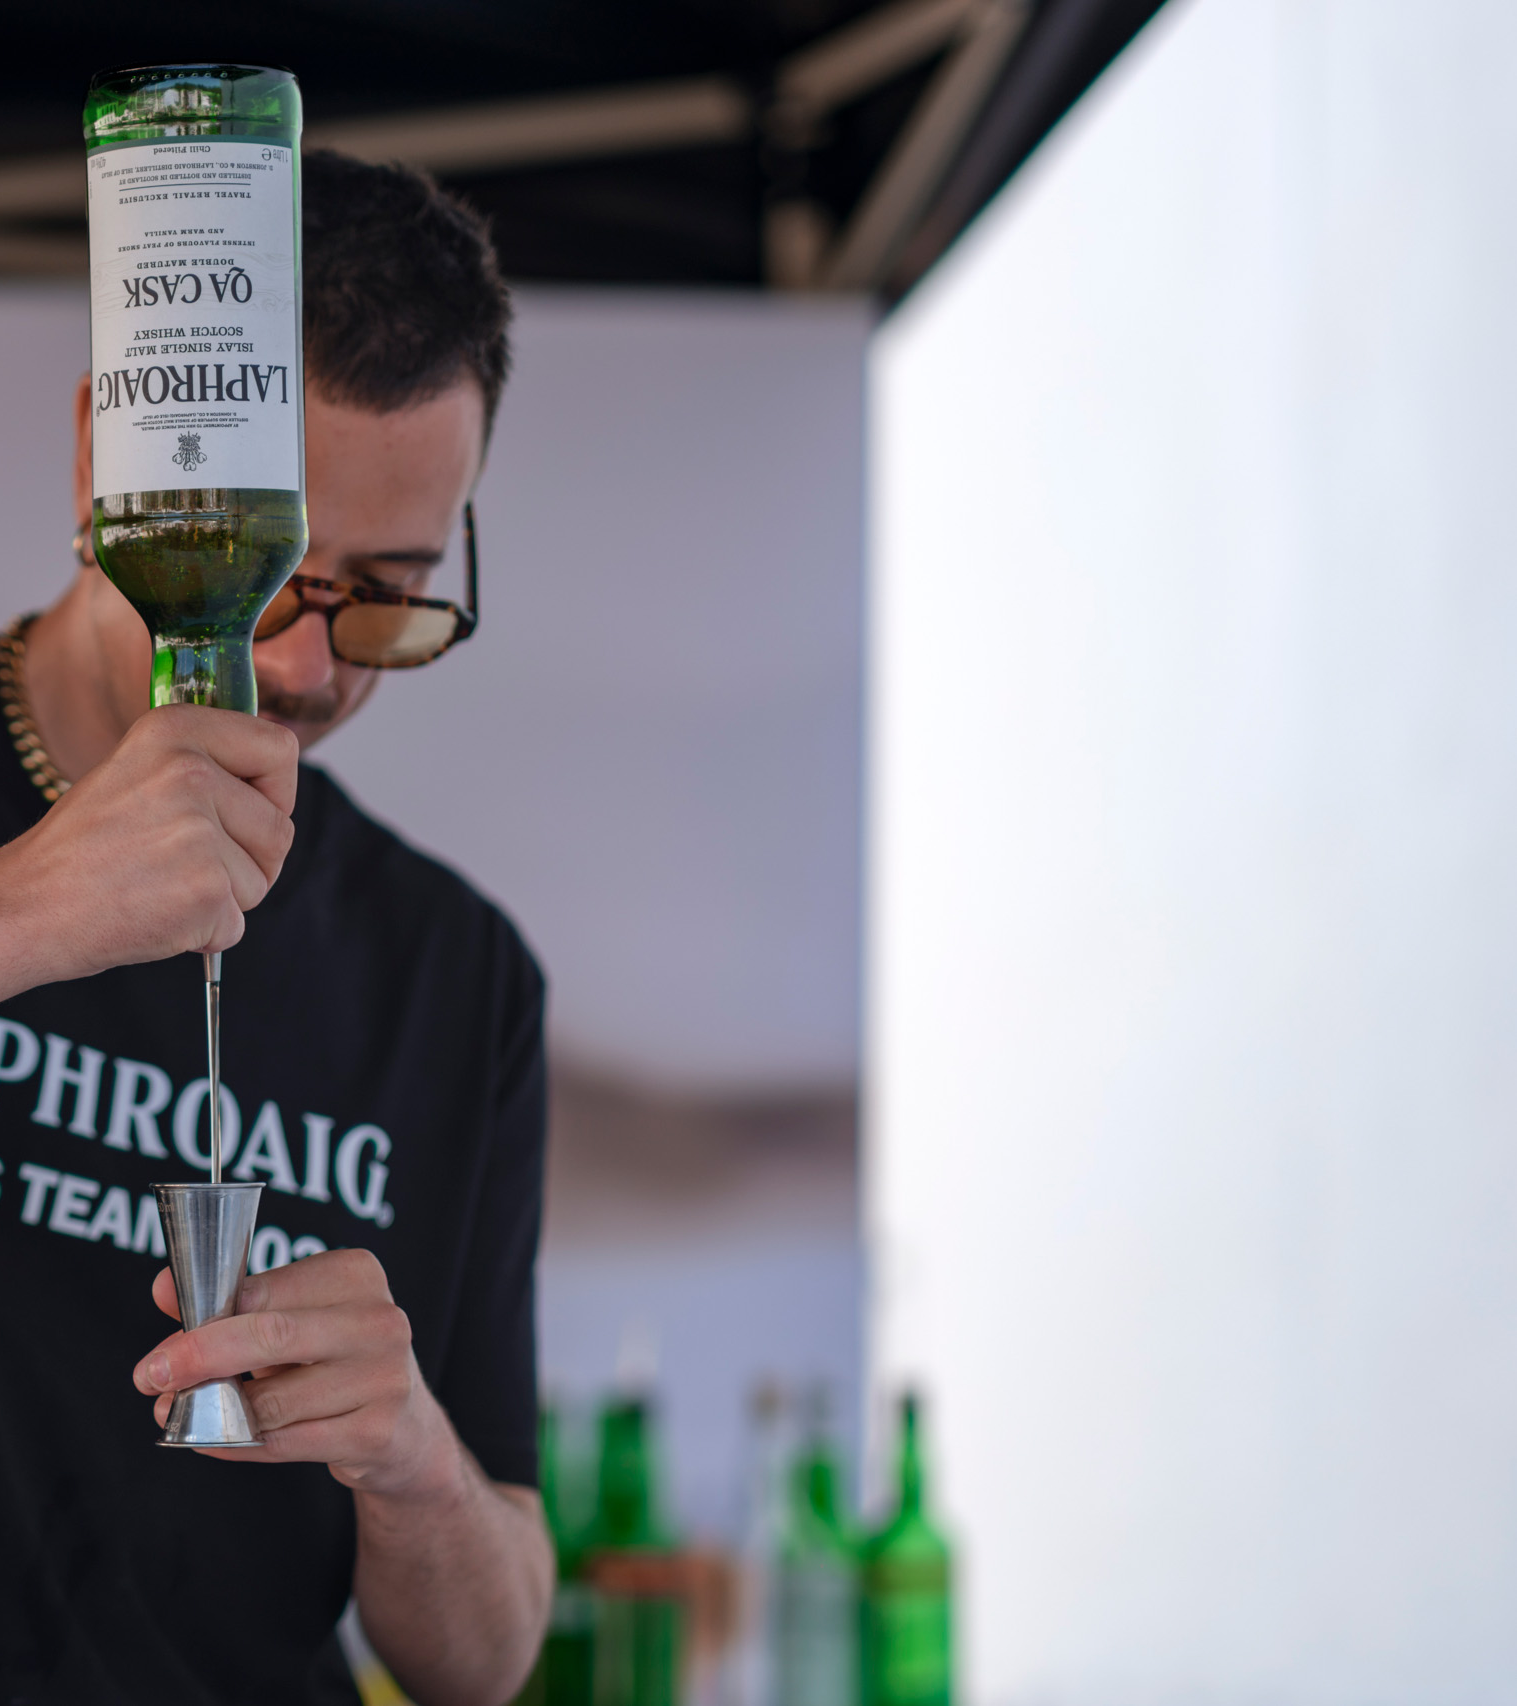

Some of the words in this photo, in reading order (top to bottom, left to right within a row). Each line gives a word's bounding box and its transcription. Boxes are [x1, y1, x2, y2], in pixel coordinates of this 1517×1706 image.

[153, 146, 187, 155] Filtered
[189, 145, 211, 153] Chill
[173, 162, 215, 170] LAPHROAIG
[236, 163, 268, 171] JOHNSTON
[126, 174, 159, 184] SCOTLAND
[169, 172, 200, 180] BOTTLED
[218, 172, 252, 180] DISTILLED
[118, 193, 169, 205] EXCLUSIVE
[172, 191, 211, 199] RETAIL
[214, 191, 252, 199] TRAVEL
[144, 229, 178, 237] VANILLA
[118, 243, 140, 253] SMOKE
[142, 241, 162, 249] PEAT
[136, 259, 187, 270] MATURED
[191, 258, 235, 266] DOUBLE
[208, 266, 253, 304] QA
[122, 273, 202, 309] CASK
[133, 327, 186, 341] WHISKY
[191, 326, 243, 337] SCOTCH
[124, 345, 157, 358] MALT
[161, 342, 212, 354] SINGLE
[216, 342, 253, 352] ISLAY
[98, 363, 289, 411] LAPHROAIG
